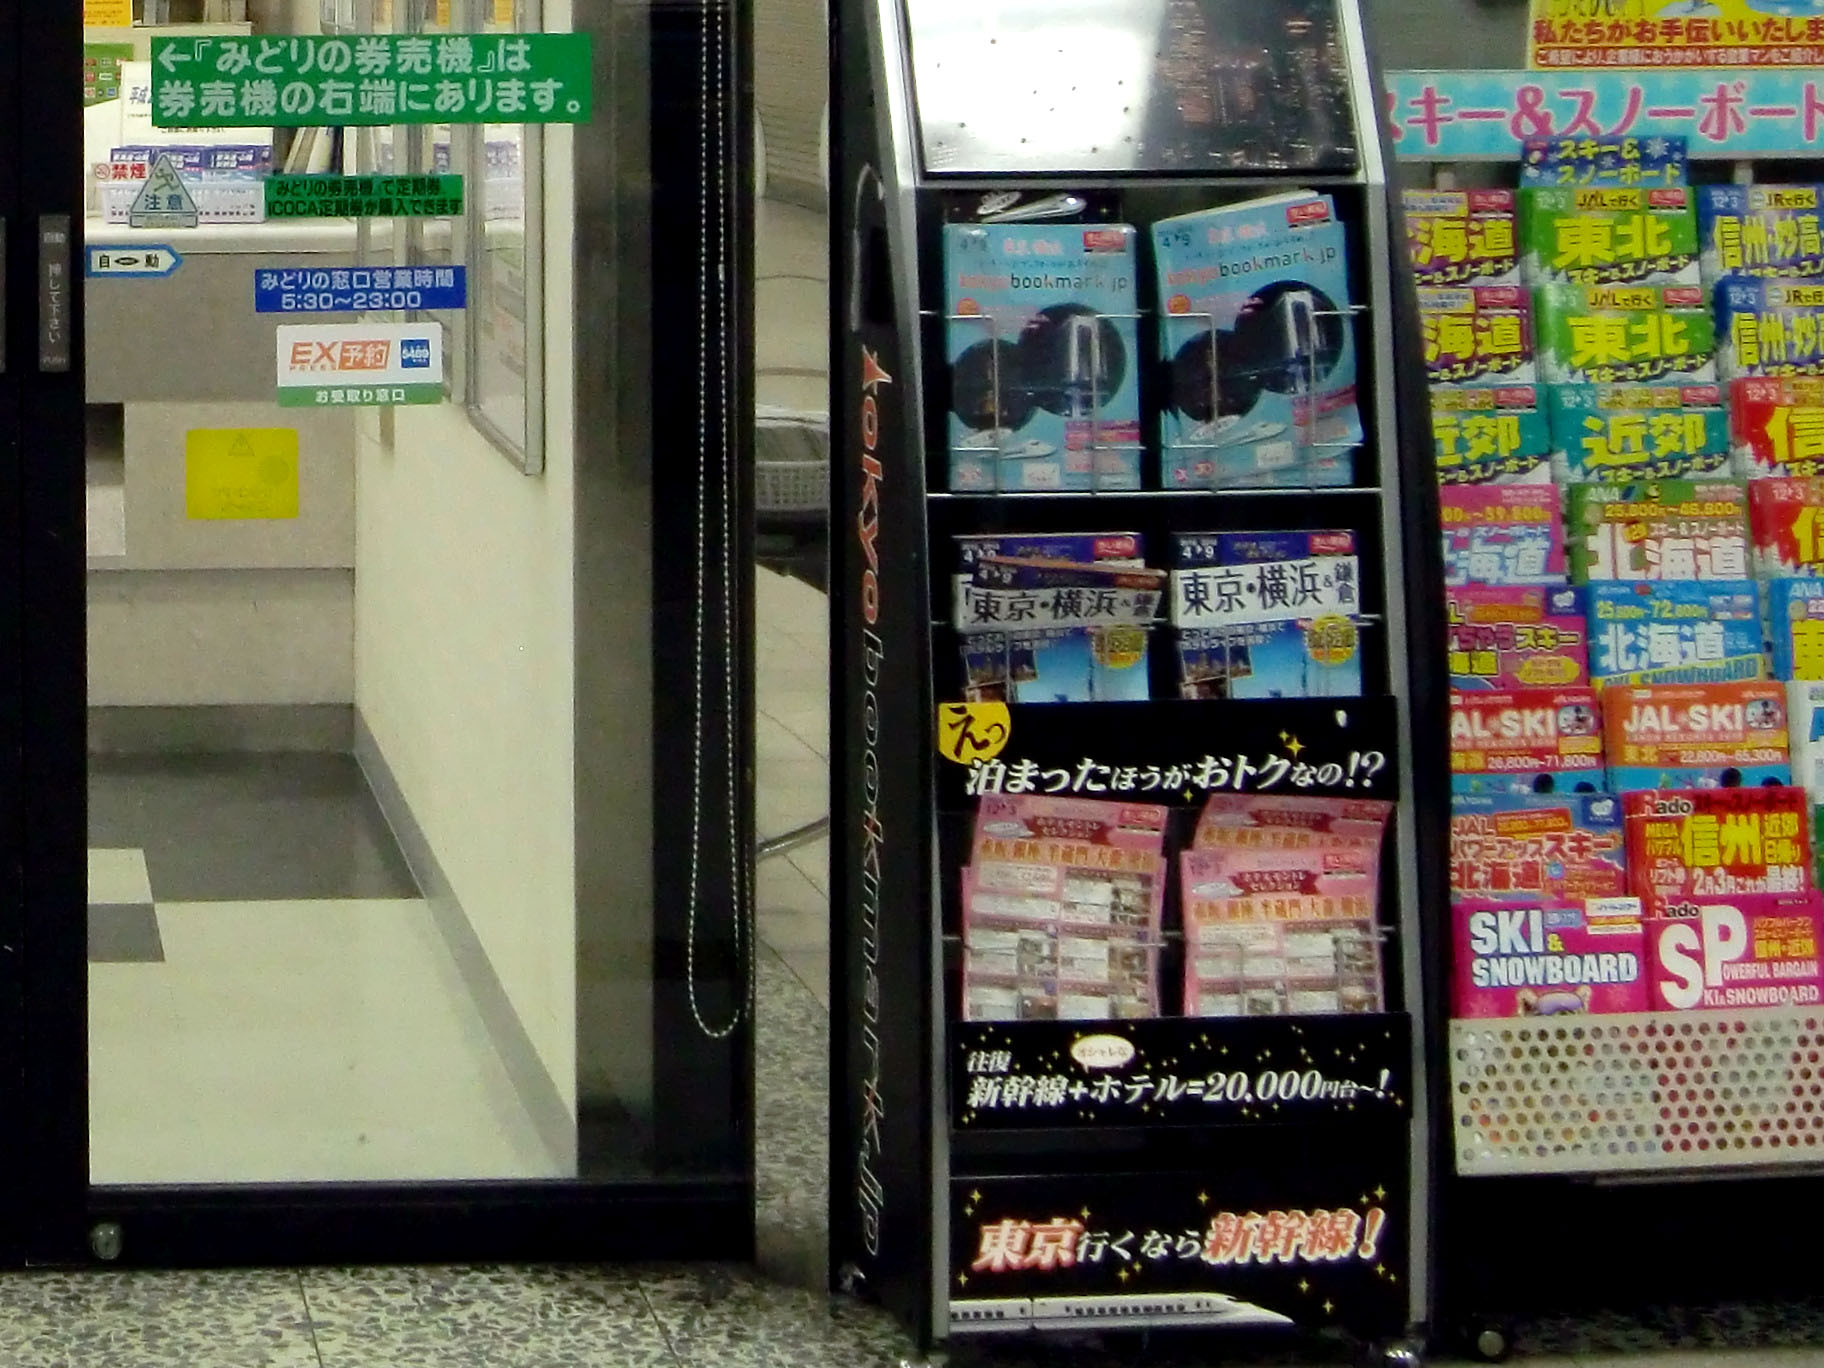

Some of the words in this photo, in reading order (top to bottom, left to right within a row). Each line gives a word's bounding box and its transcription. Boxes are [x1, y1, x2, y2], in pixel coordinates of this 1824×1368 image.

[157, 78, 582, 118] 券売機の右端にあります。
[111, 163, 147, 180] 禁煙
[143, 193, 184, 212] 注意
[1553, 214, 1673, 269] 東北
[261, 269, 454, 291] みどりの窓口営業時間
[1567, 314, 1692, 369] 東北
[315, 388, 406, 404] お受取り窓口
[1582, 414, 1707, 468] 近郊
[1598, 623, 1725, 672] 北海道
[1451, 710, 1491, 739] AL
[1500, 710, 1556, 739] SKI
[1623, 705, 1679, 733] JAL
[1688, 704, 1743, 732] SKI
[1681, 813, 1761, 867] 信州
[1469, 909, 1544, 954] SKI
[1472, 953, 1638, 987] SNOWBOARD
[1772, 959, 1818, 979] BARGAIN
[966, 1050, 1013, 1073] 往復
